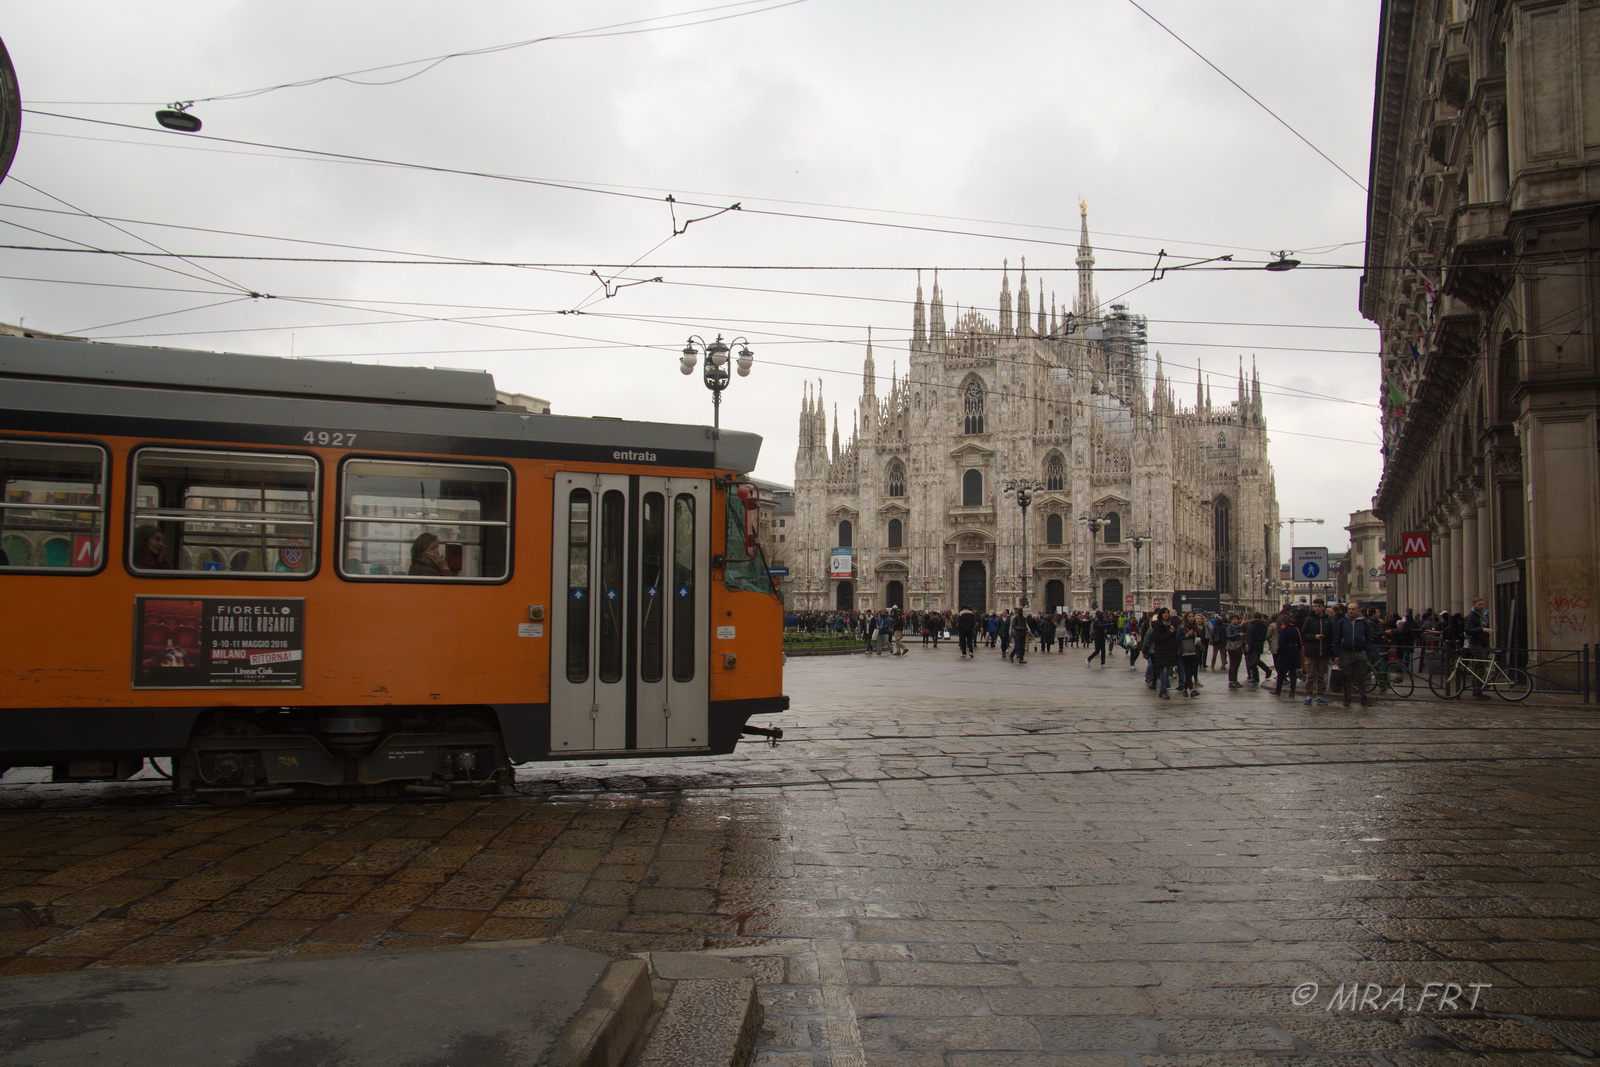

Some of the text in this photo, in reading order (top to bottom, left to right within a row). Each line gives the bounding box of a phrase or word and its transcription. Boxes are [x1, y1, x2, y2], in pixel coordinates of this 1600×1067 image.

[303, 431, 357, 447] 4927
[613, 450, 657, 462] entrata
[1404, 537, 1427, 553] M
[1387, 559, 1404, 570] M
[217, 605, 291, 615] FIORELLO
[211, 616, 295, 632] L'ORA DEL ROSARIO
[1548, 614, 1586, 632] TAV
[241, 640, 270, 648] MAGGIO
[270, 640, 288, 648] 2016
[212, 649, 246, 659] MILANO
[252, 652, 292, 664] RITORNA!
